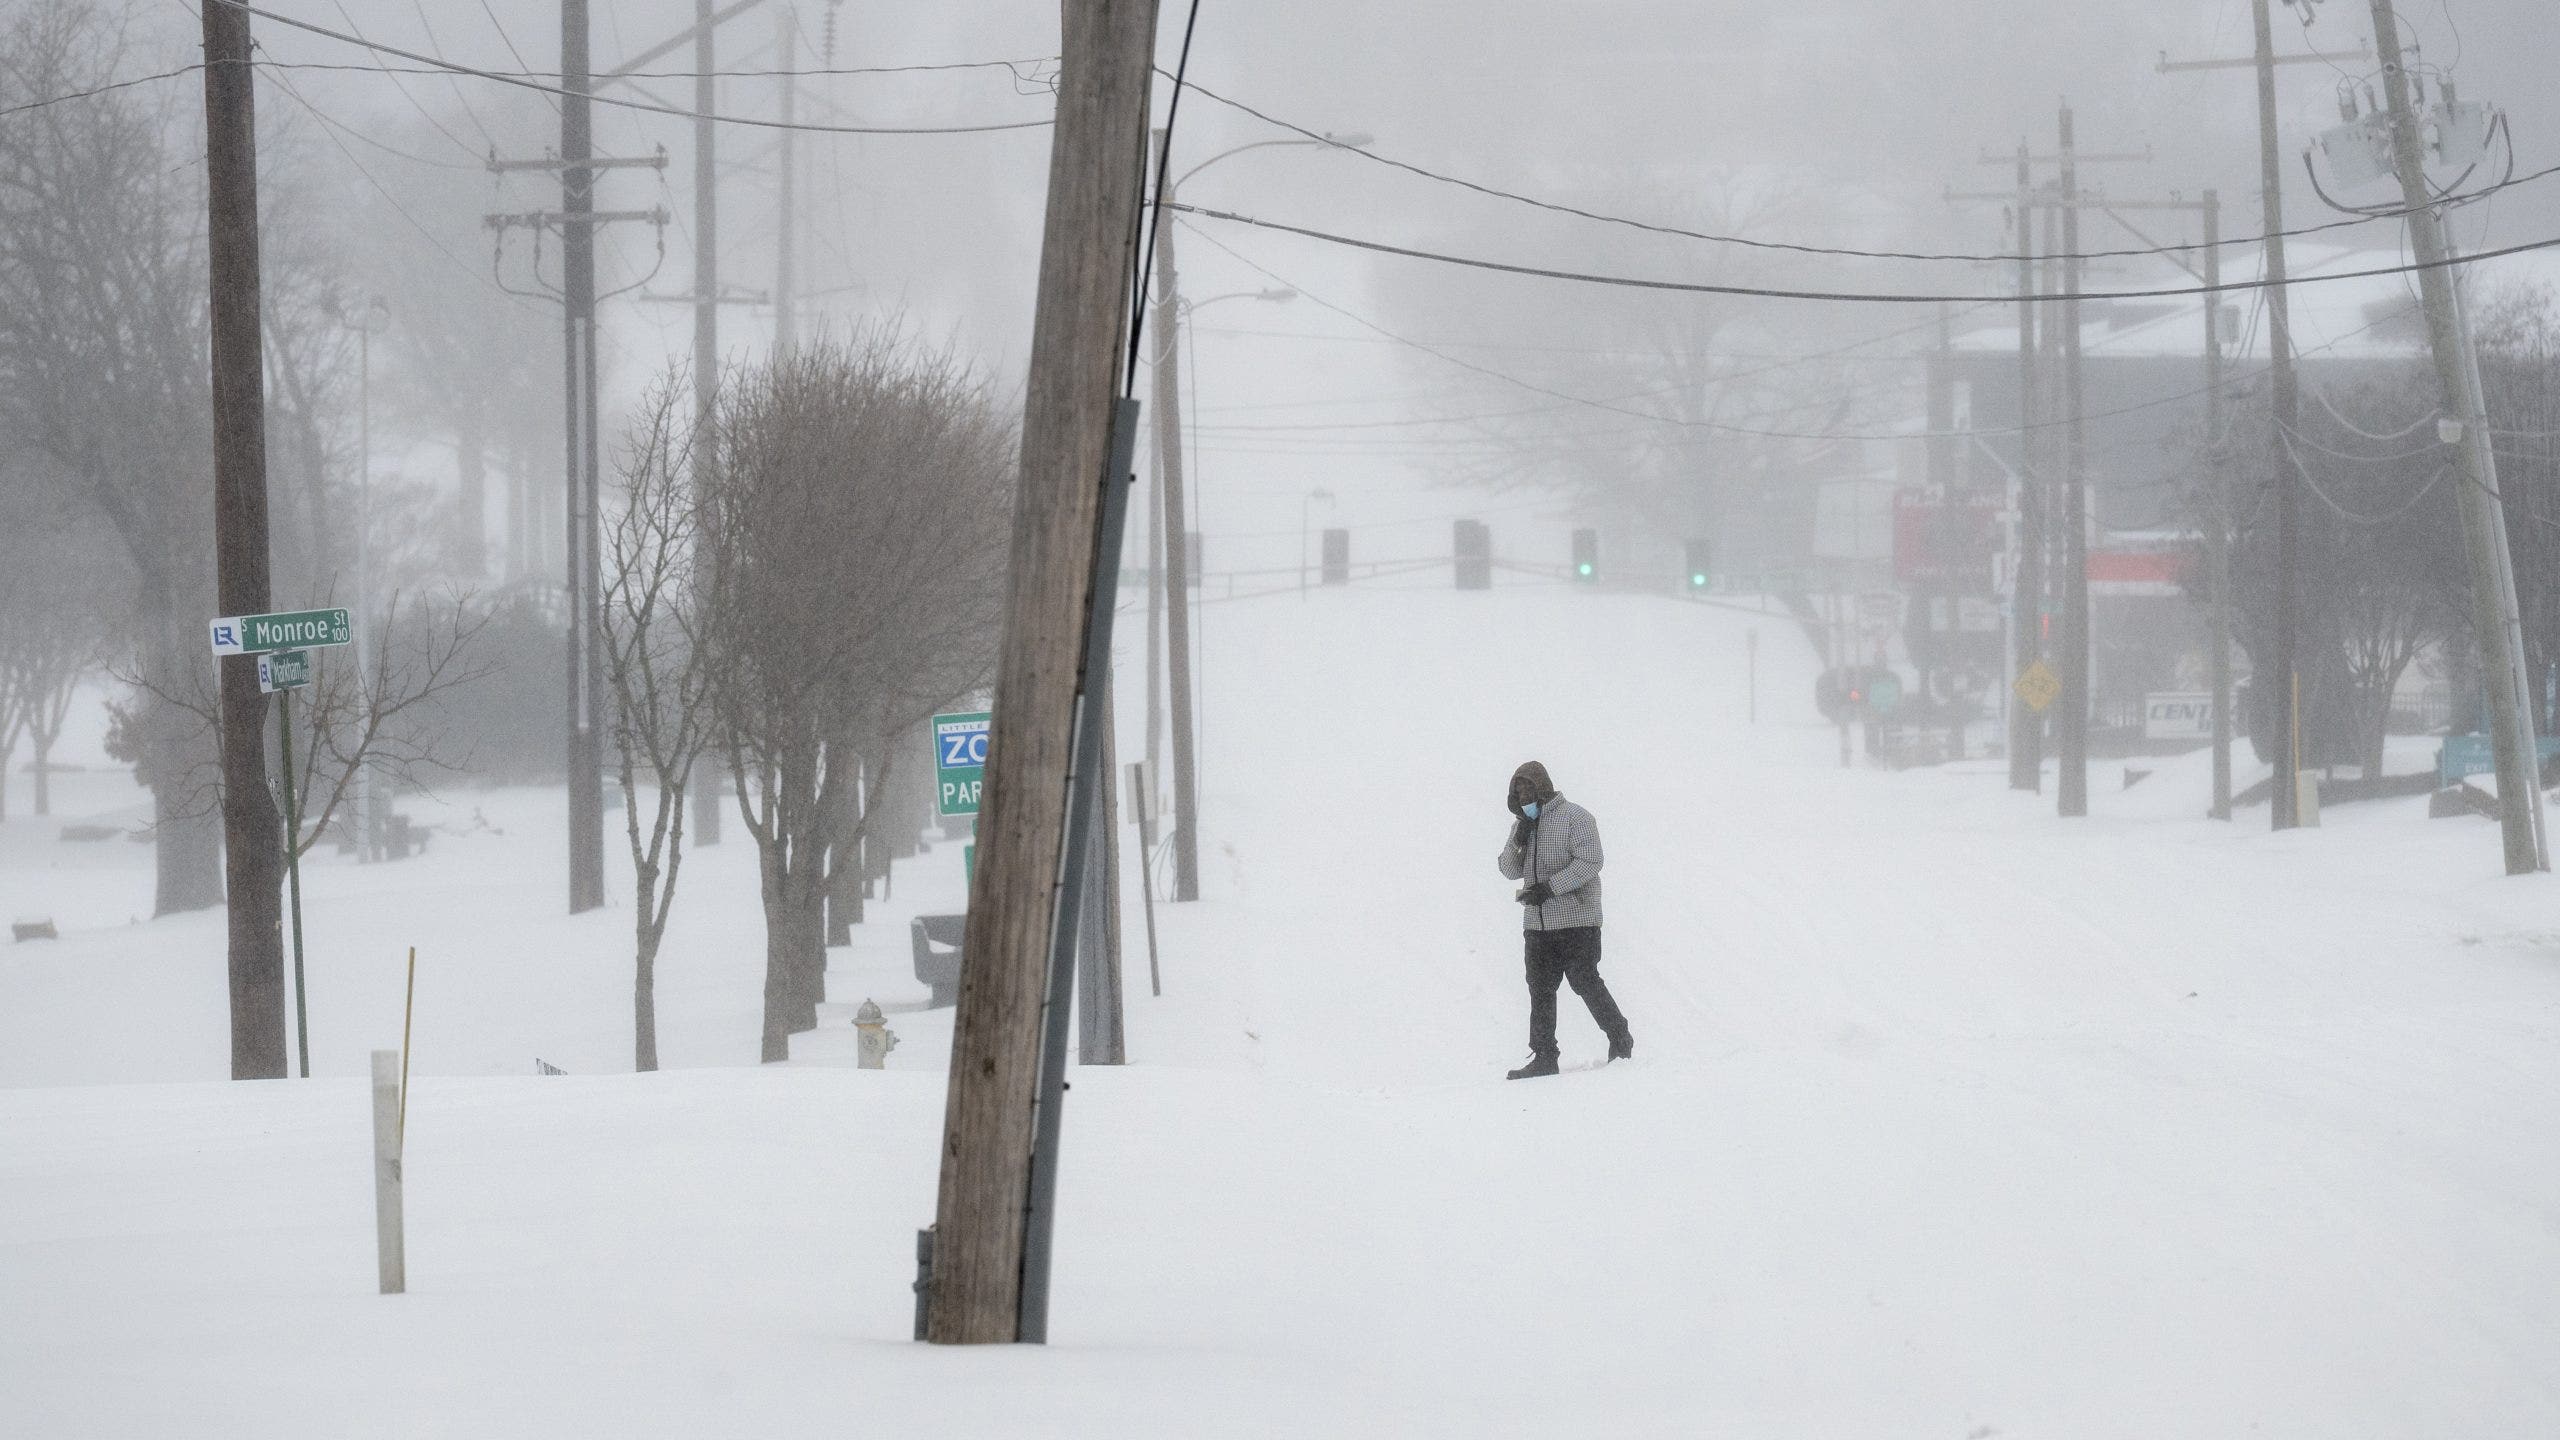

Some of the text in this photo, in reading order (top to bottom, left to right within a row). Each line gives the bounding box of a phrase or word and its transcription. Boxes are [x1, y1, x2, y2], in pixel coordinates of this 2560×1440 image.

[241, 610, 346, 644] S Monroe St
[332, 627, 348, 641] 100
[273, 659, 303, 683] Markham
[942, 724, 983, 732] LITTLE
[942, 781, 982, 805] PAR
